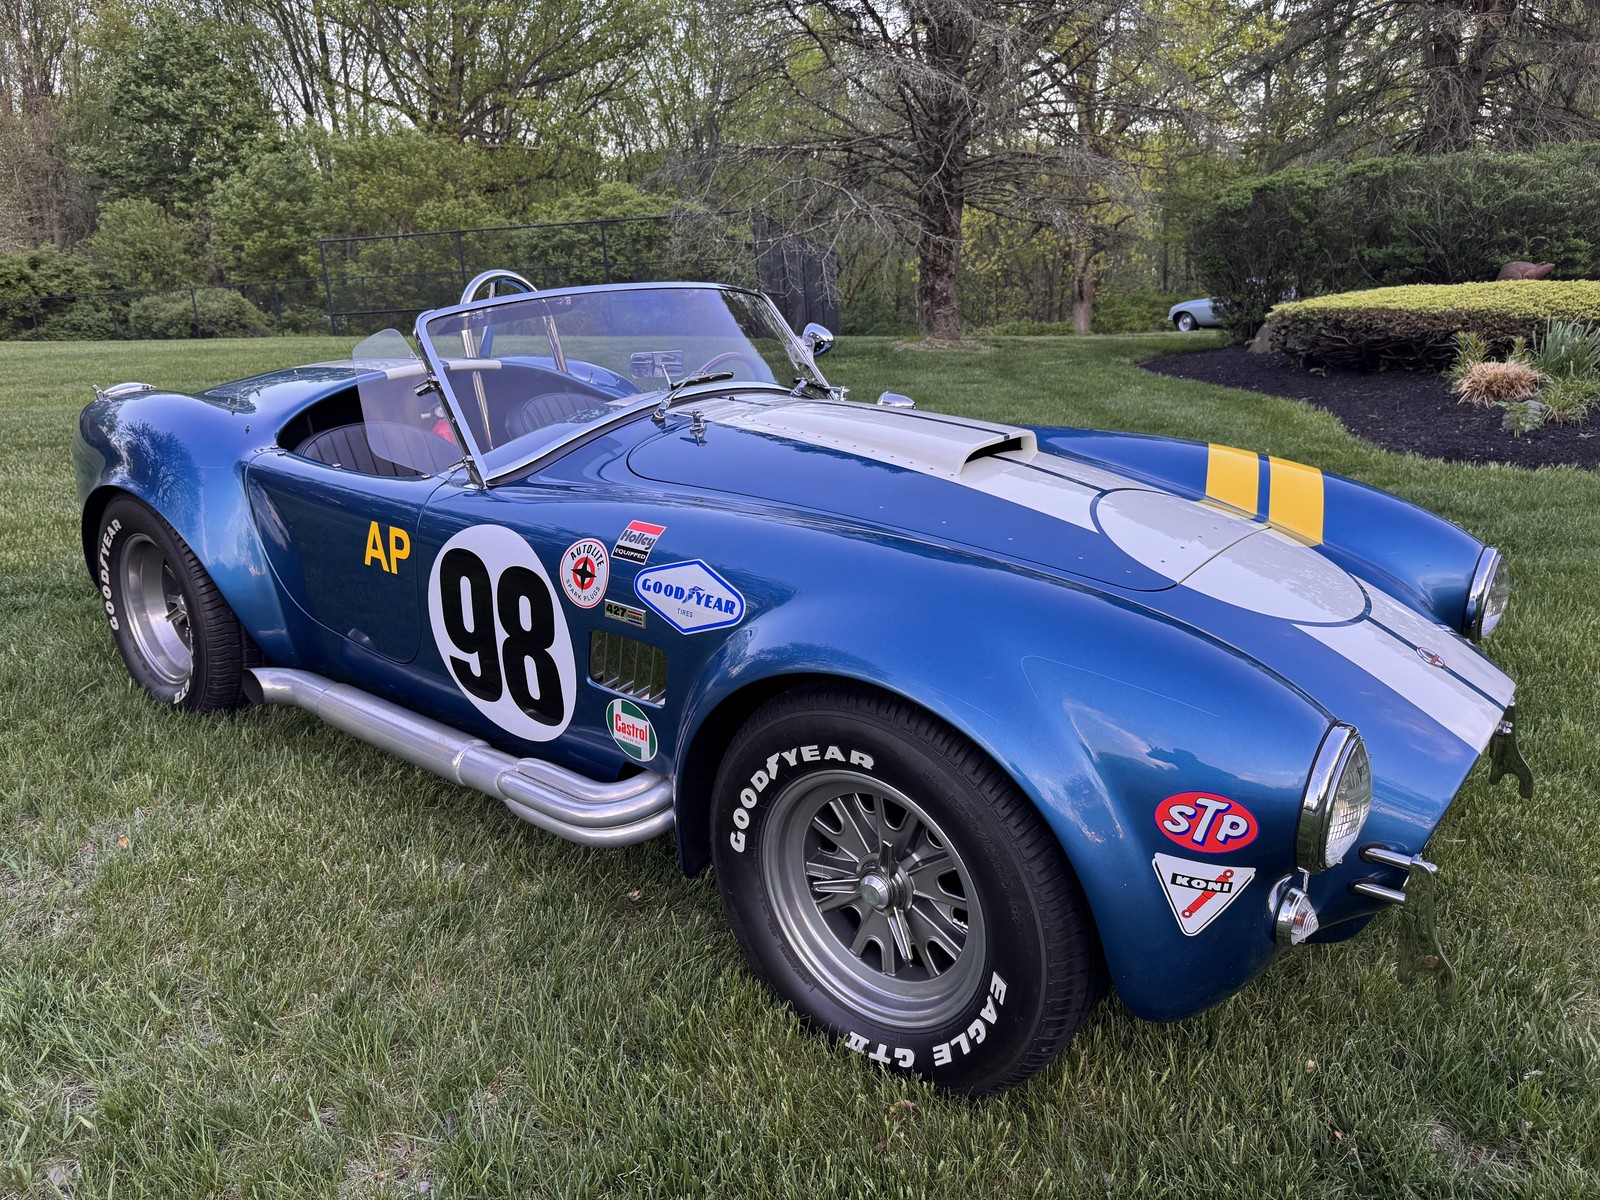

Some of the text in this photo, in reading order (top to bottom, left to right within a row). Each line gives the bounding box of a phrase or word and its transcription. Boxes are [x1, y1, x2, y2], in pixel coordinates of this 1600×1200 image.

[364, 521, 411, 575] AP
[614, 546, 647, 560] EQUIPPED
[620, 530, 656, 551] Holley
[570, 544, 605, 568] AUTOLITE
[100, 519, 122, 631] GOODYEAR
[565, 578, 601, 602] SPARK PLUGS
[641, 578, 736, 615] GOODYEAR
[606, 603, 627, 617] 427
[676, 607, 693, 618] TIRES
[439, 547, 565, 727] 98
[615, 713, 648, 742] Castrol
[730, 745, 875, 853] GOODYEAR
[1162, 797, 1250, 846] STP
[1174, 875, 1230, 892] KONI
[932, 971, 1008, 1067] EAGLE
